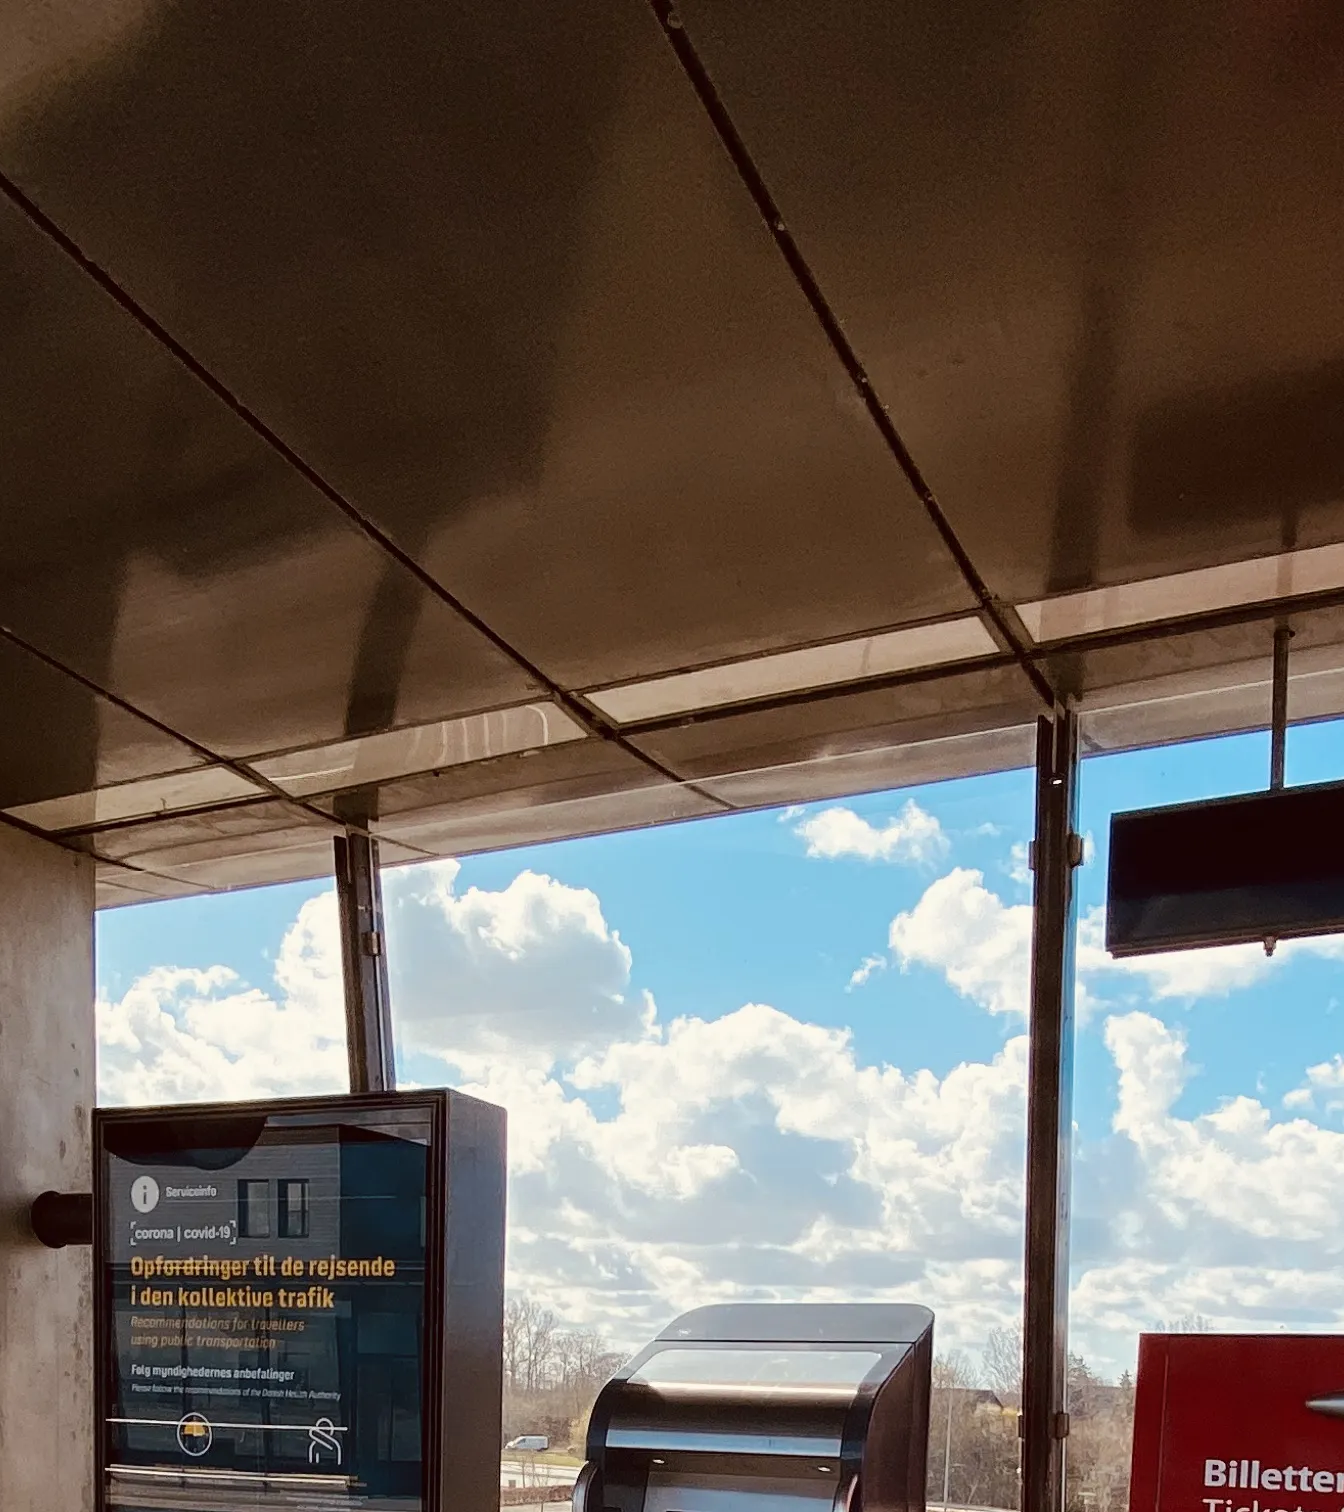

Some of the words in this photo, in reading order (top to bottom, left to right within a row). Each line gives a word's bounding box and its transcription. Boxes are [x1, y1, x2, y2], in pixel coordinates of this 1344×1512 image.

[134, 1228, 174, 1240] corona
[183, 1225, 231, 1240] covid-19
[130, 1255, 250, 1281] Opfordringer
[254, 1254, 277, 1277] til
[281, 1256, 305, 1277] de
[308, 1256, 396, 1281] rejsende
[130, 1285, 136, 1306] i
[140, 1286, 173, 1307] den
[178, 1285, 274, 1308] kollektive
[277, 1288, 335, 1310] trafik
[130, 1315, 230, 1331] Recommendations
[250, 1317, 305, 1332] travellers
[130, 1334, 159, 1349] using
[196, 1335, 277, 1351] transportation
[233, 1366, 296, 1383] anbefalinger
